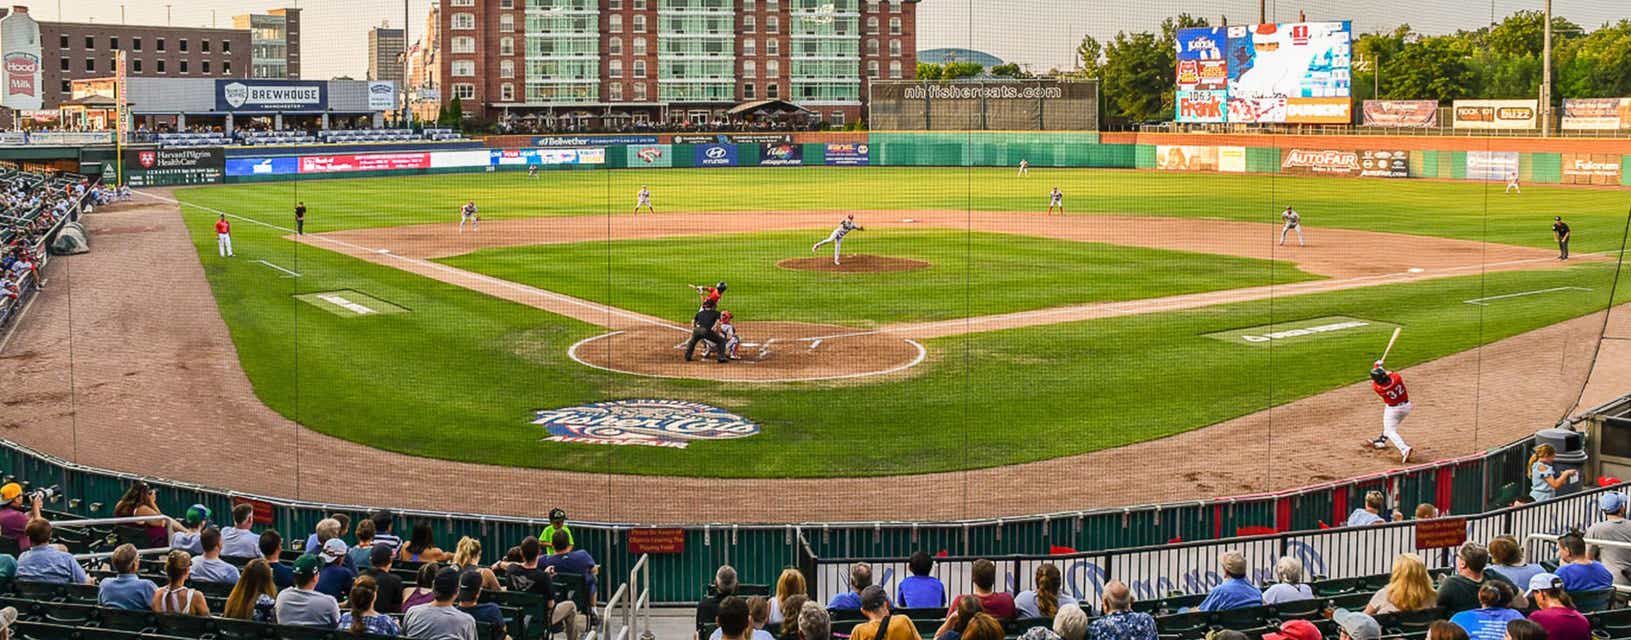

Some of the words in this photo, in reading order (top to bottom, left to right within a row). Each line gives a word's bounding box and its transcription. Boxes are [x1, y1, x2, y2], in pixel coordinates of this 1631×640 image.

[7, 62, 36, 71] Hood
[11, 79, 32, 89] Milk
[252, 89, 317, 99] BREWHOUSE
[904, 85, 1062, 99] nhfishercats.com
[1180, 97, 1222, 117] Frank
[157, 151, 186, 159] Harvard
[187, 150, 211, 159] Pilgrim
[1386, 384, 1405, 400] 32
